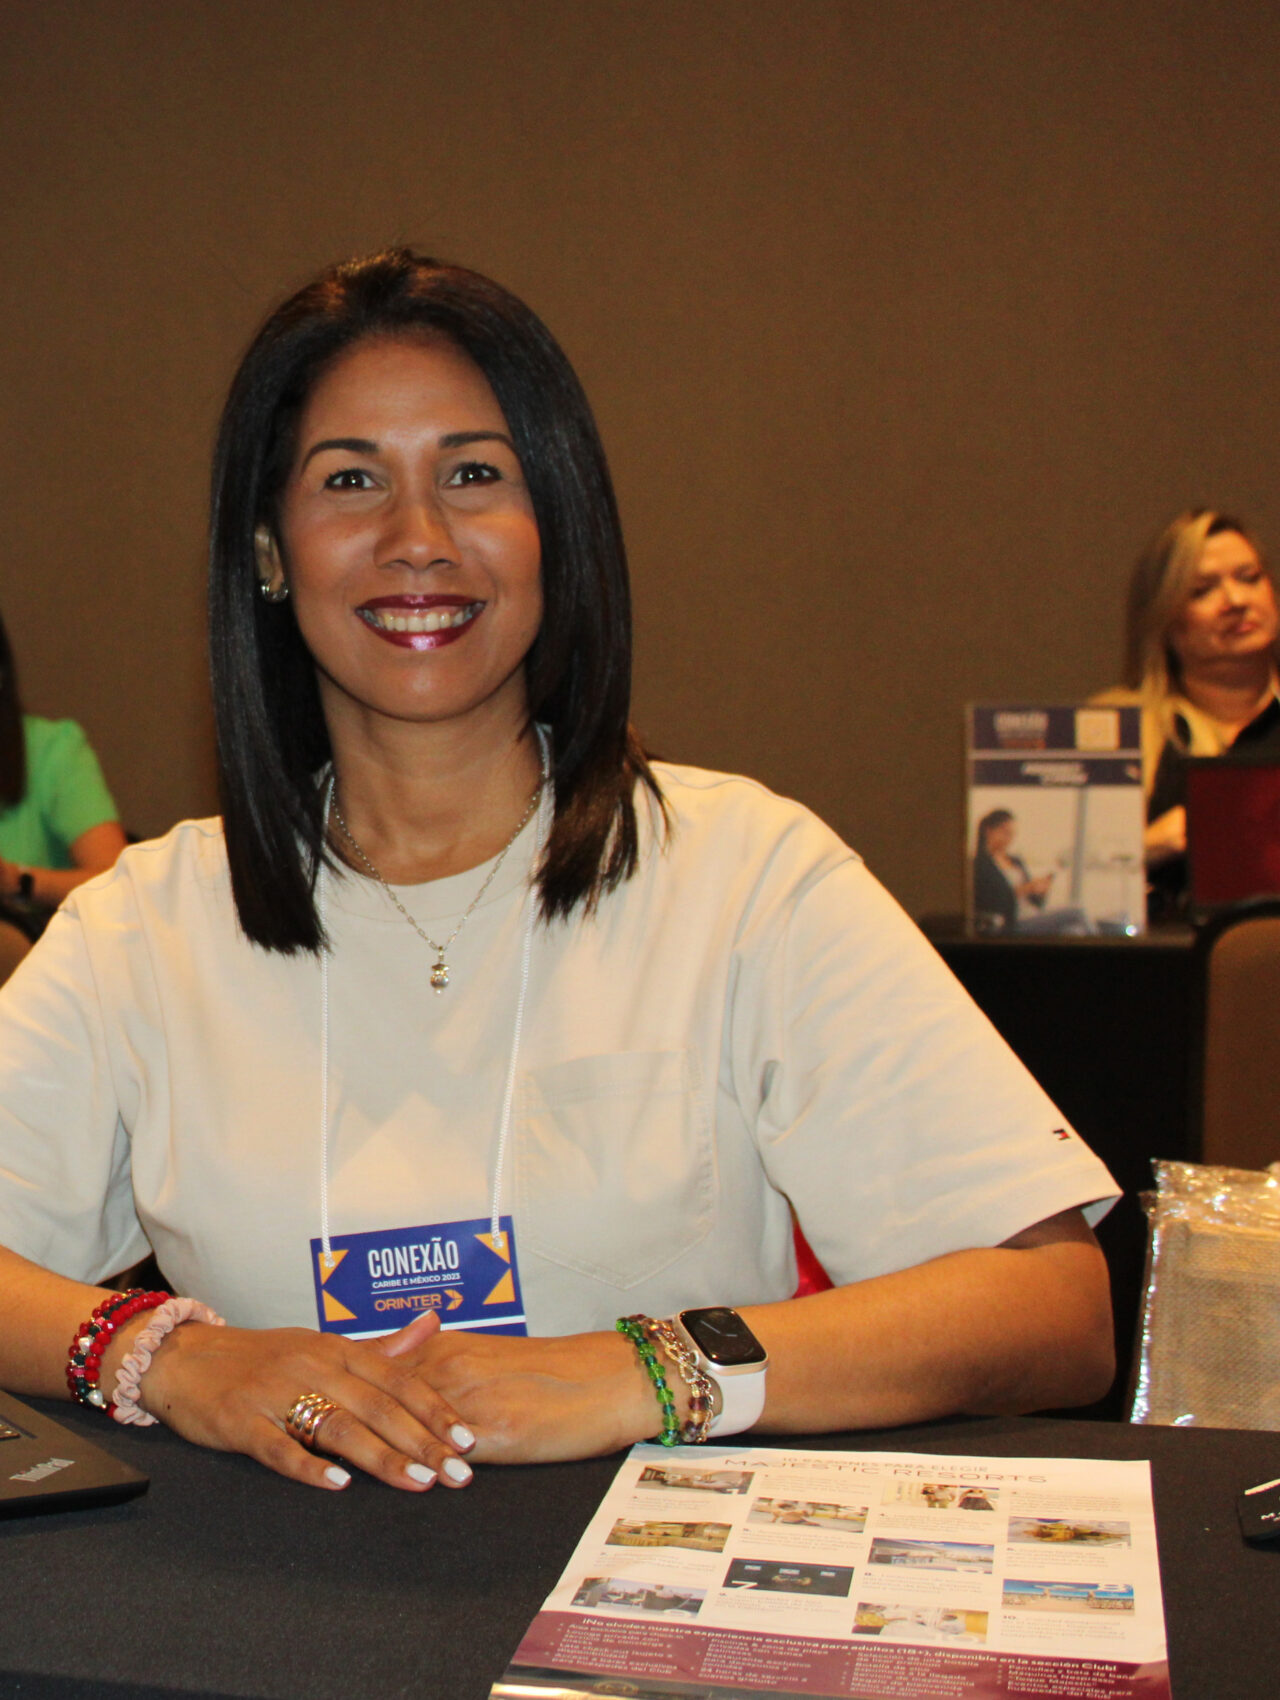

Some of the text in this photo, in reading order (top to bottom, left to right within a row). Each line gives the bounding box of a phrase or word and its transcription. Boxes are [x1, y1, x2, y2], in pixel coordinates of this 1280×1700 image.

[368, 1237, 459, 1278] CONEXÃO
[372, 1279, 402, 1288] CARIBE
[410, 1275, 440, 1285] MÉXICO
[442, 1273, 460, 1281] 2023
[375, 1294, 442, 1311] ORINTER
[725, 1459, 1047, 1483] MAJESTIC RESORTS
[606, 1621, 646, 1630] olvides
[648, 1625, 691, 1635] nuestra
[694, 1630, 763, 1643] experiencia
[765, 1638, 819, 1648] exclusiva
[821, 1643, 849, 1651] para
[851, 1645, 895, 1654] adultos
[935, 1651, 997, 1662] disponible
[1018, 1657, 1029, 1665] la
